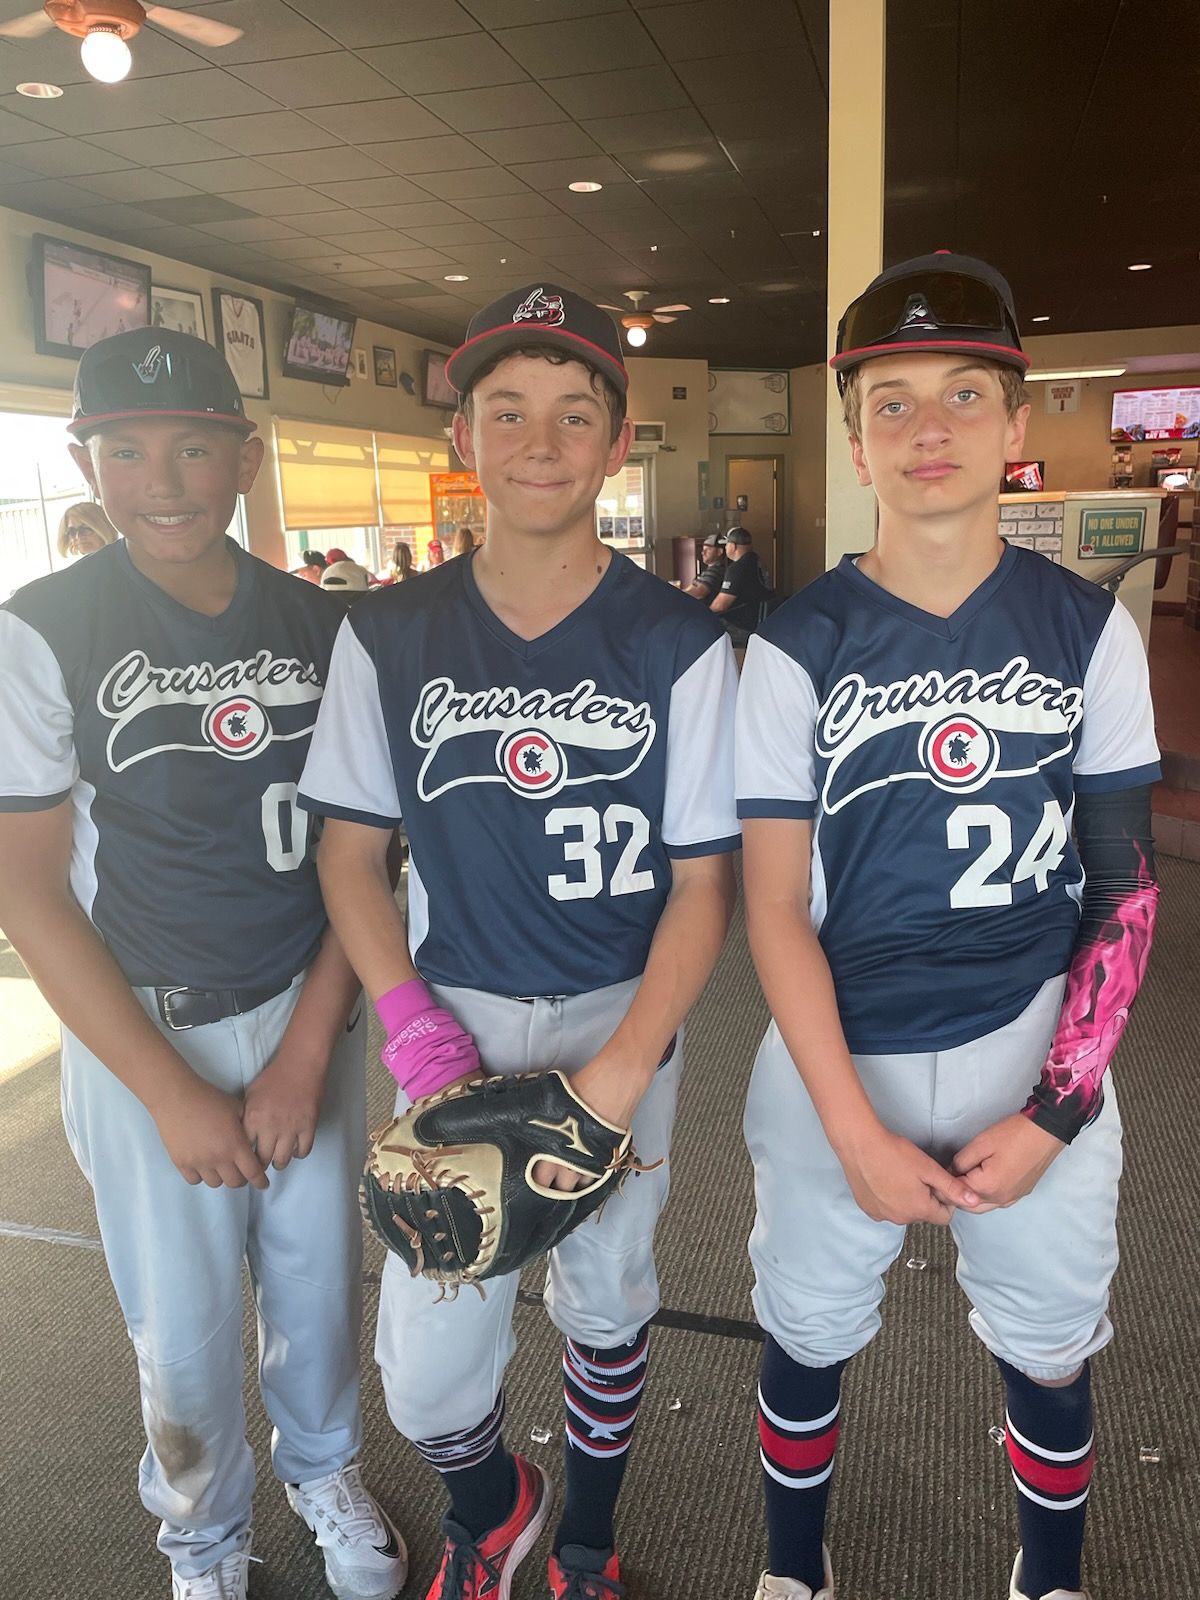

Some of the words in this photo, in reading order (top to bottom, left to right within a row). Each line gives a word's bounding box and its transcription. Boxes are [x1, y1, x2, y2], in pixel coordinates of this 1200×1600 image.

[226, 330, 255, 350] GIANTS
[1088, 518, 1099, 530] NO
[1100, 517, 1115, 530] ONE
[1115, 516, 1139, 529] UNDER
[1090, 535, 1100, 547] 21
[1101, 534, 1135, 547] ALLOWED
[98, 650, 323, 719] Crusaders
[411, 678, 652, 748] Crusaders
[815, 656, 1084, 757] Crusaders
[544, 803, 656, 902] 32
[945, 800, 1066, 910] 24
